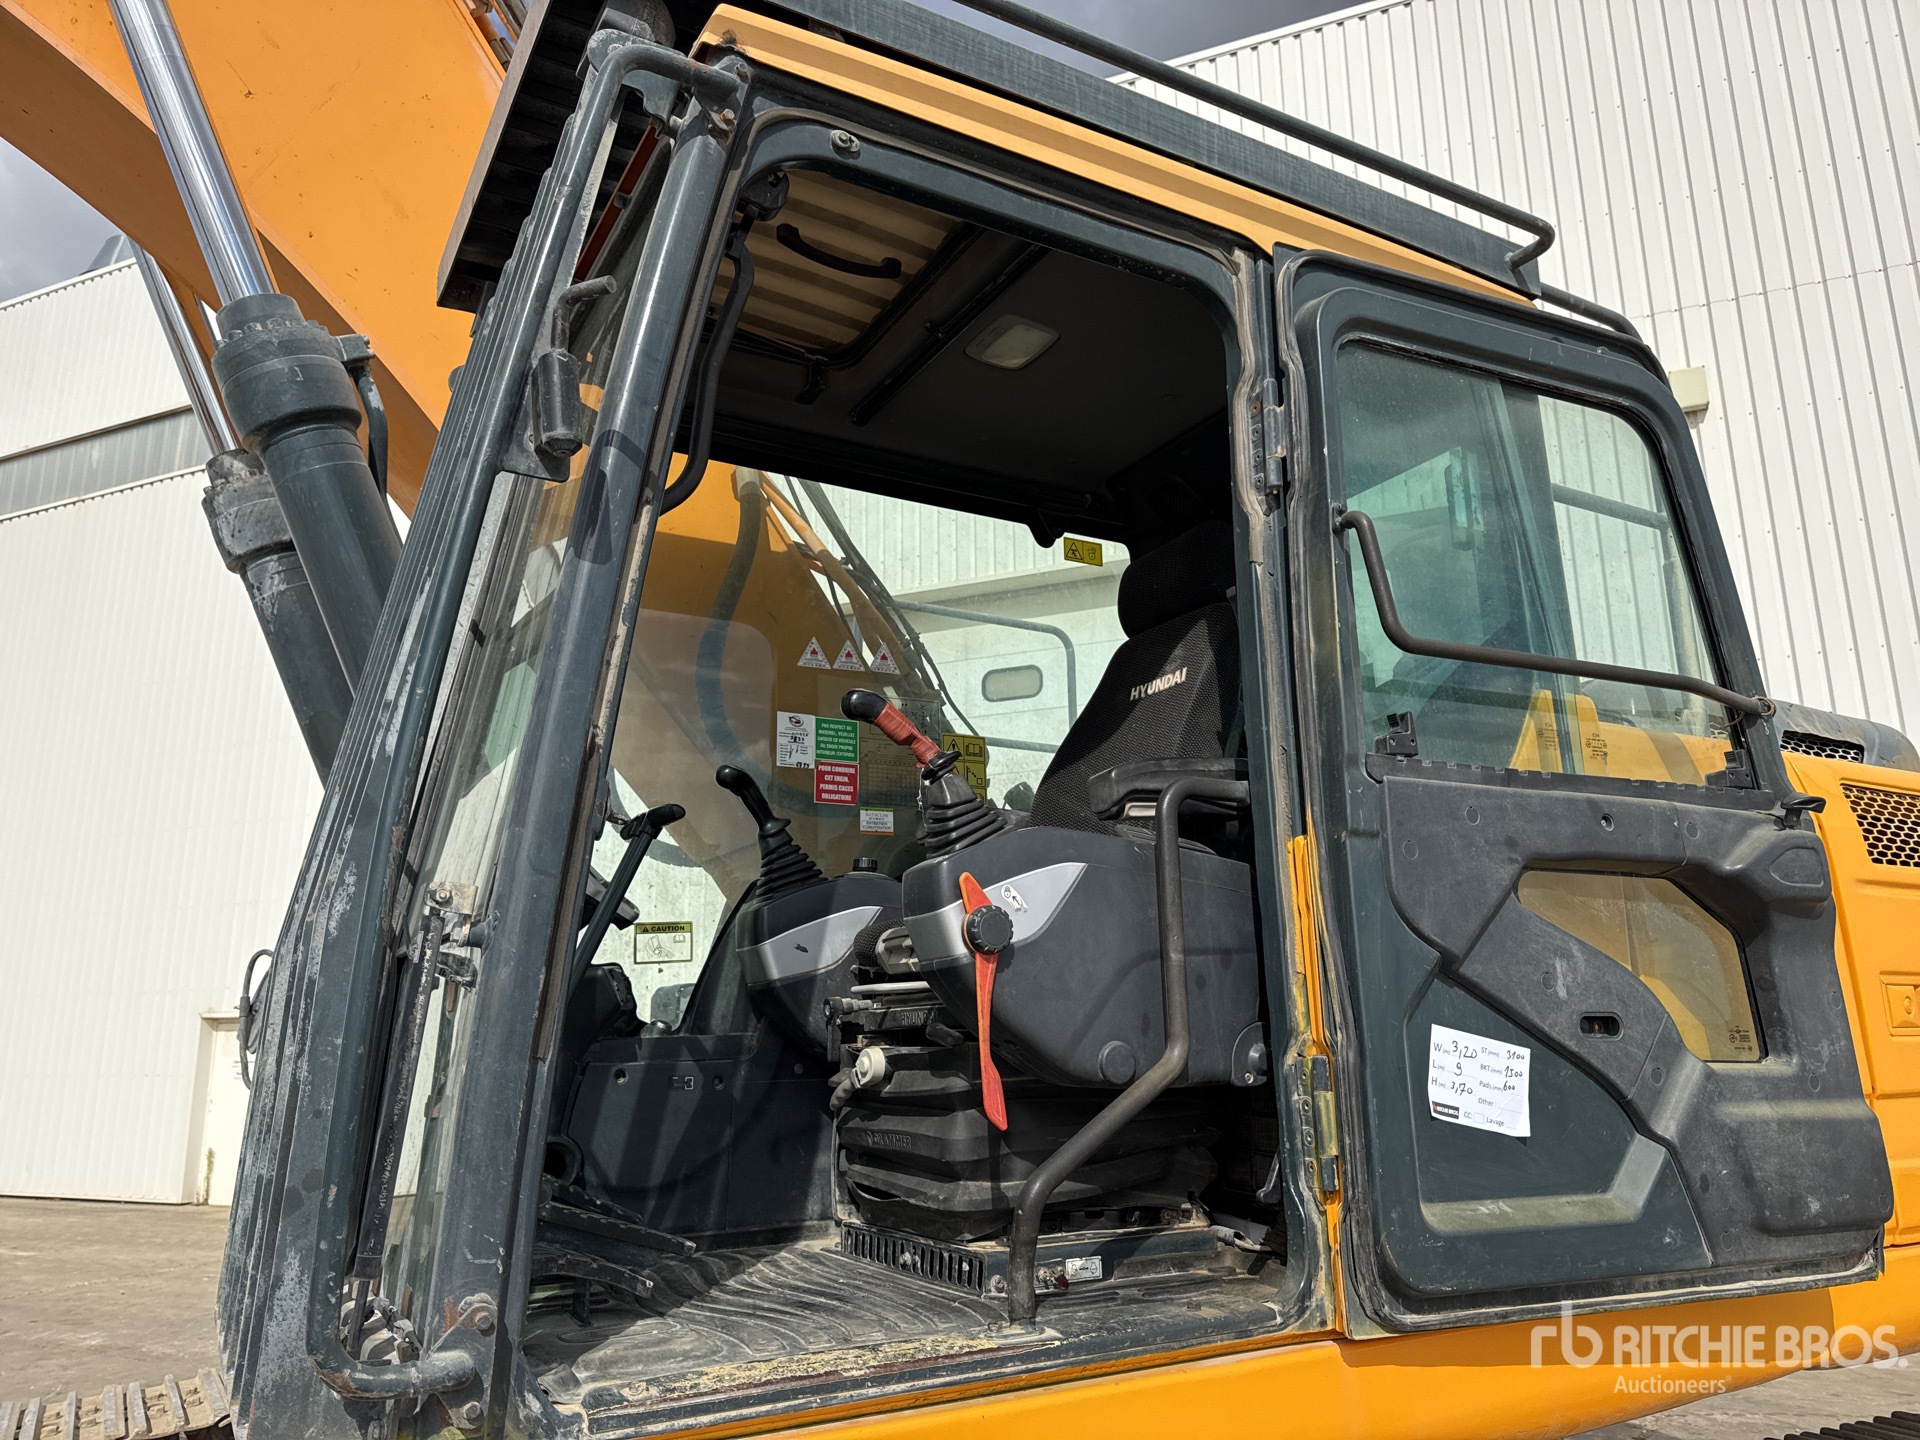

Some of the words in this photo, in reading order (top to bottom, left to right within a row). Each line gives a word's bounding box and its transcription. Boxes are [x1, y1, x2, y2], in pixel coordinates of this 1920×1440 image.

[1130, 666, 1187, 700] HYUNDAI
[832, 766, 855, 774] CONDUIRE
[1452, 1040, 1477, 1059] 3,20
[1507, 1050, 1525, 1060] 3100
[1504, 1065, 1522, 1078] 1500
[1451, 1081, 1473, 1096] 3,70
[1503, 1080, 1515, 1091] 600
[1486, 1117, 1505, 1127] Lavage
